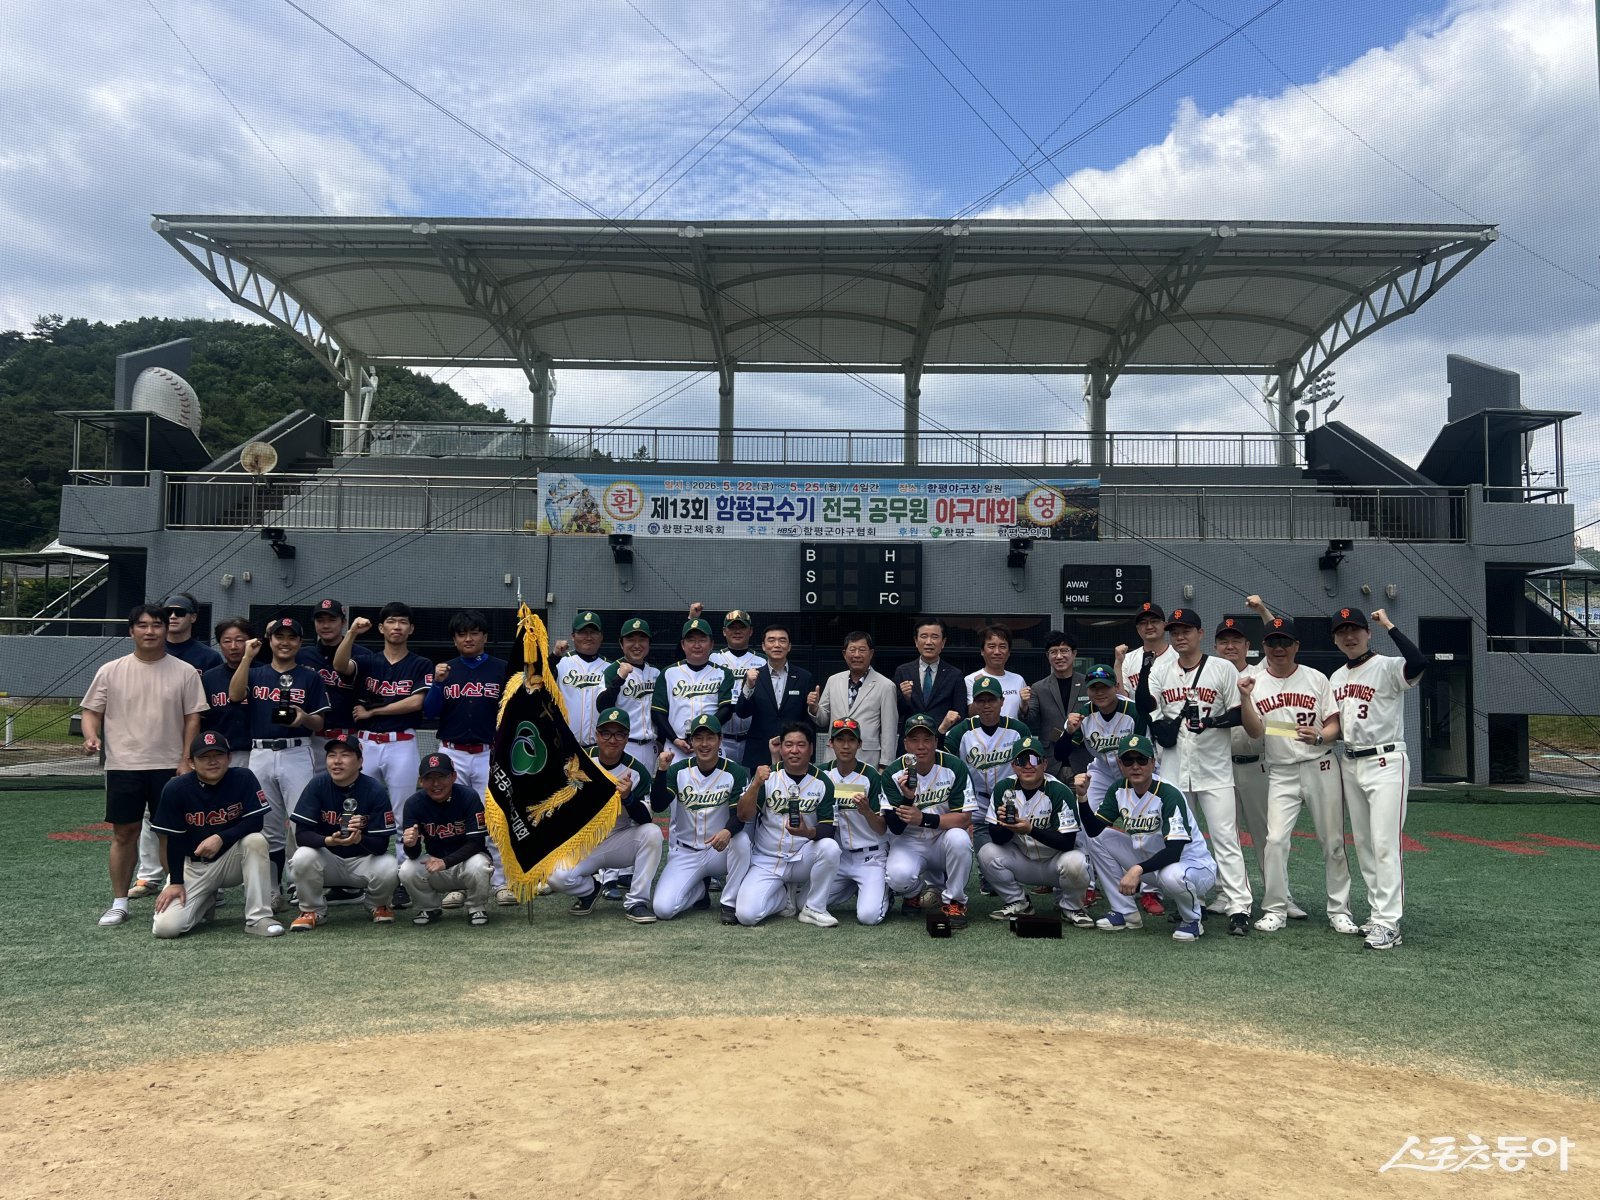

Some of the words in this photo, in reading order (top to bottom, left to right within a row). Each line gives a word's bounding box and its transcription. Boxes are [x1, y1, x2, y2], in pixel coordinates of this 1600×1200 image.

[693, 481, 719, 490] 2026.
[852, 483, 879, 492] 4일간
[927, 484, 980, 494] 함평야구장
[984, 484, 1002, 493] 일원
[611, 488, 638, 514] 환
[1034, 493, 1055, 519] 영
[651, 496, 708, 520] 제13회
[716, 495, 815, 522] 함평군수기
[823, 497, 861, 523] 전국
[869, 498, 928, 524] 공무원
[935, 498, 1015, 524] 야구대회
[616, 524, 636, 532] 주최
[662, 524, 725, 534] 함평군체육회
[747, 526, 767, 535] 주관
[803, 527, 876, 537] 함평군야구협회
[899, 527, 918, 536] 후원
[944, 527, 976, 537] 함평군
[806, 550, 816, 562] B
[885, 550, 895, 562] H
[806, 571, 816, 583] S
[885, 571, 894, 583] E
[1115, 568, 1122, 578] B
[1066, 581, 1089, 589] AWAY
[1115, 581, 1122, 590] S
[805, 592, 817, 604] O
[879, 593, 899, 605] FC
[1066, 594, 1090, 602] HOME
[1114, 594, 1124, 603] O
[365, 677, 414, 696] 예산군
[443, 682, 500, 698] 예산군
[1256, 692, 1317, 716] FULLSWINGS
[1357, 704, 1369, 719] 3
[1296, 713, 1317, 727] 27
[1320, 760, 1331, 771] 27
[1378, 757, 1387, 767] 3
[677, 786, 731, 808] Springs
[185, 802, 244, 827] 예산군
